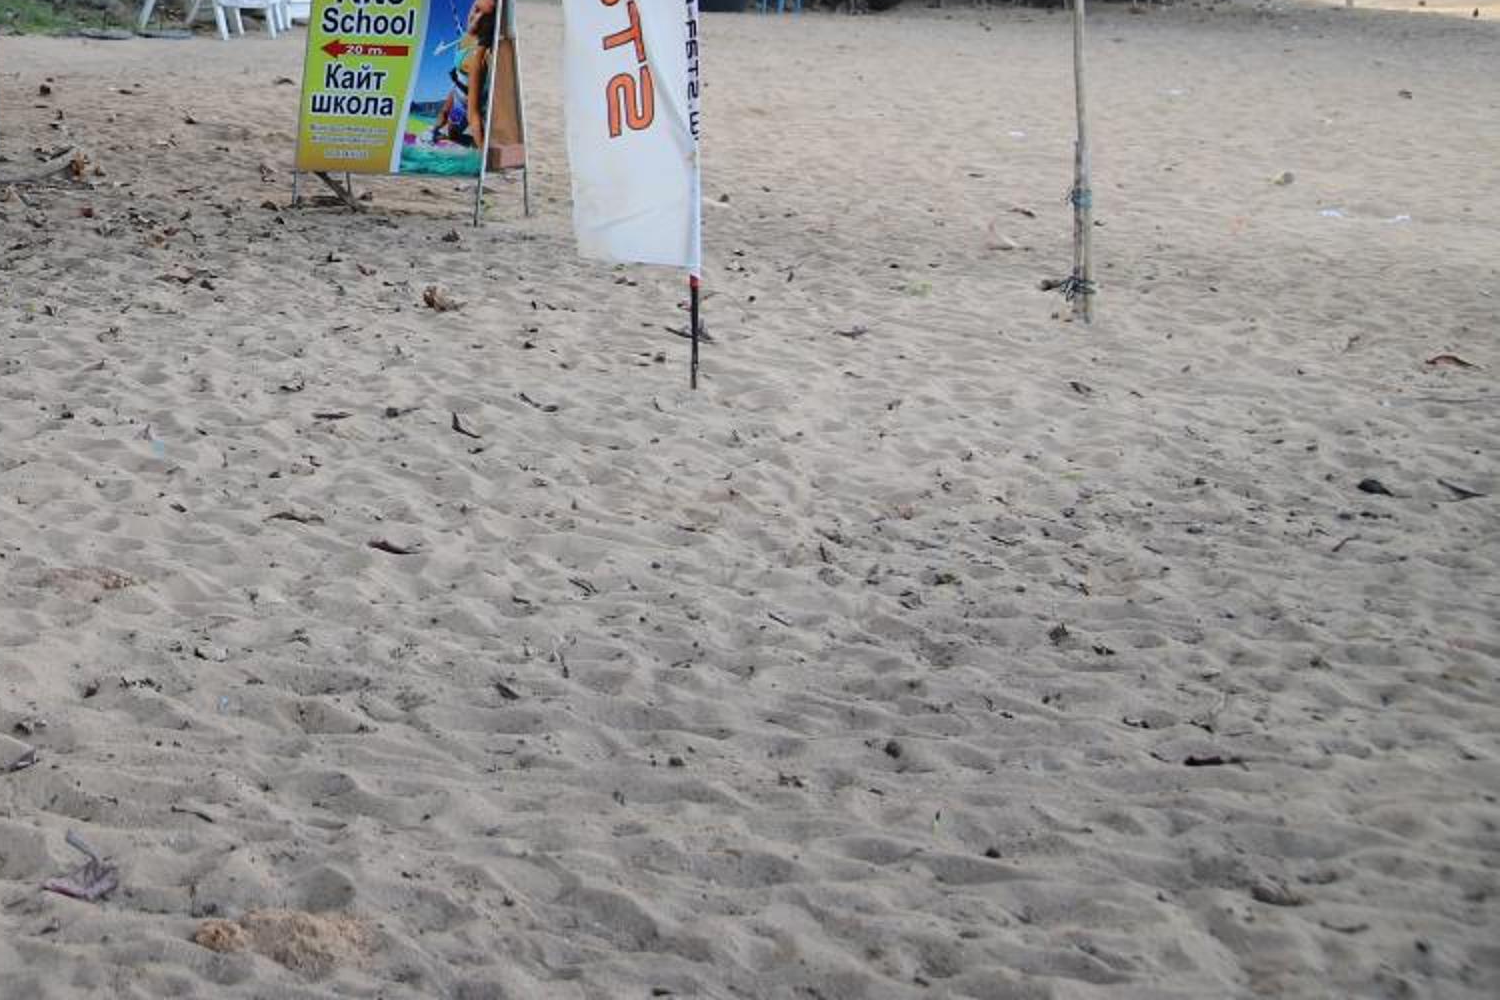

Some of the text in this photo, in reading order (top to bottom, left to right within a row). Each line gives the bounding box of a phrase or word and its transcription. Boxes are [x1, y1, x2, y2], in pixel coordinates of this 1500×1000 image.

[322, 7, 414, 35] School
[346, 44, 363, 56] 20
[325, 64, 386, 90] Кайт
[311, 95, 394, 116] школа
